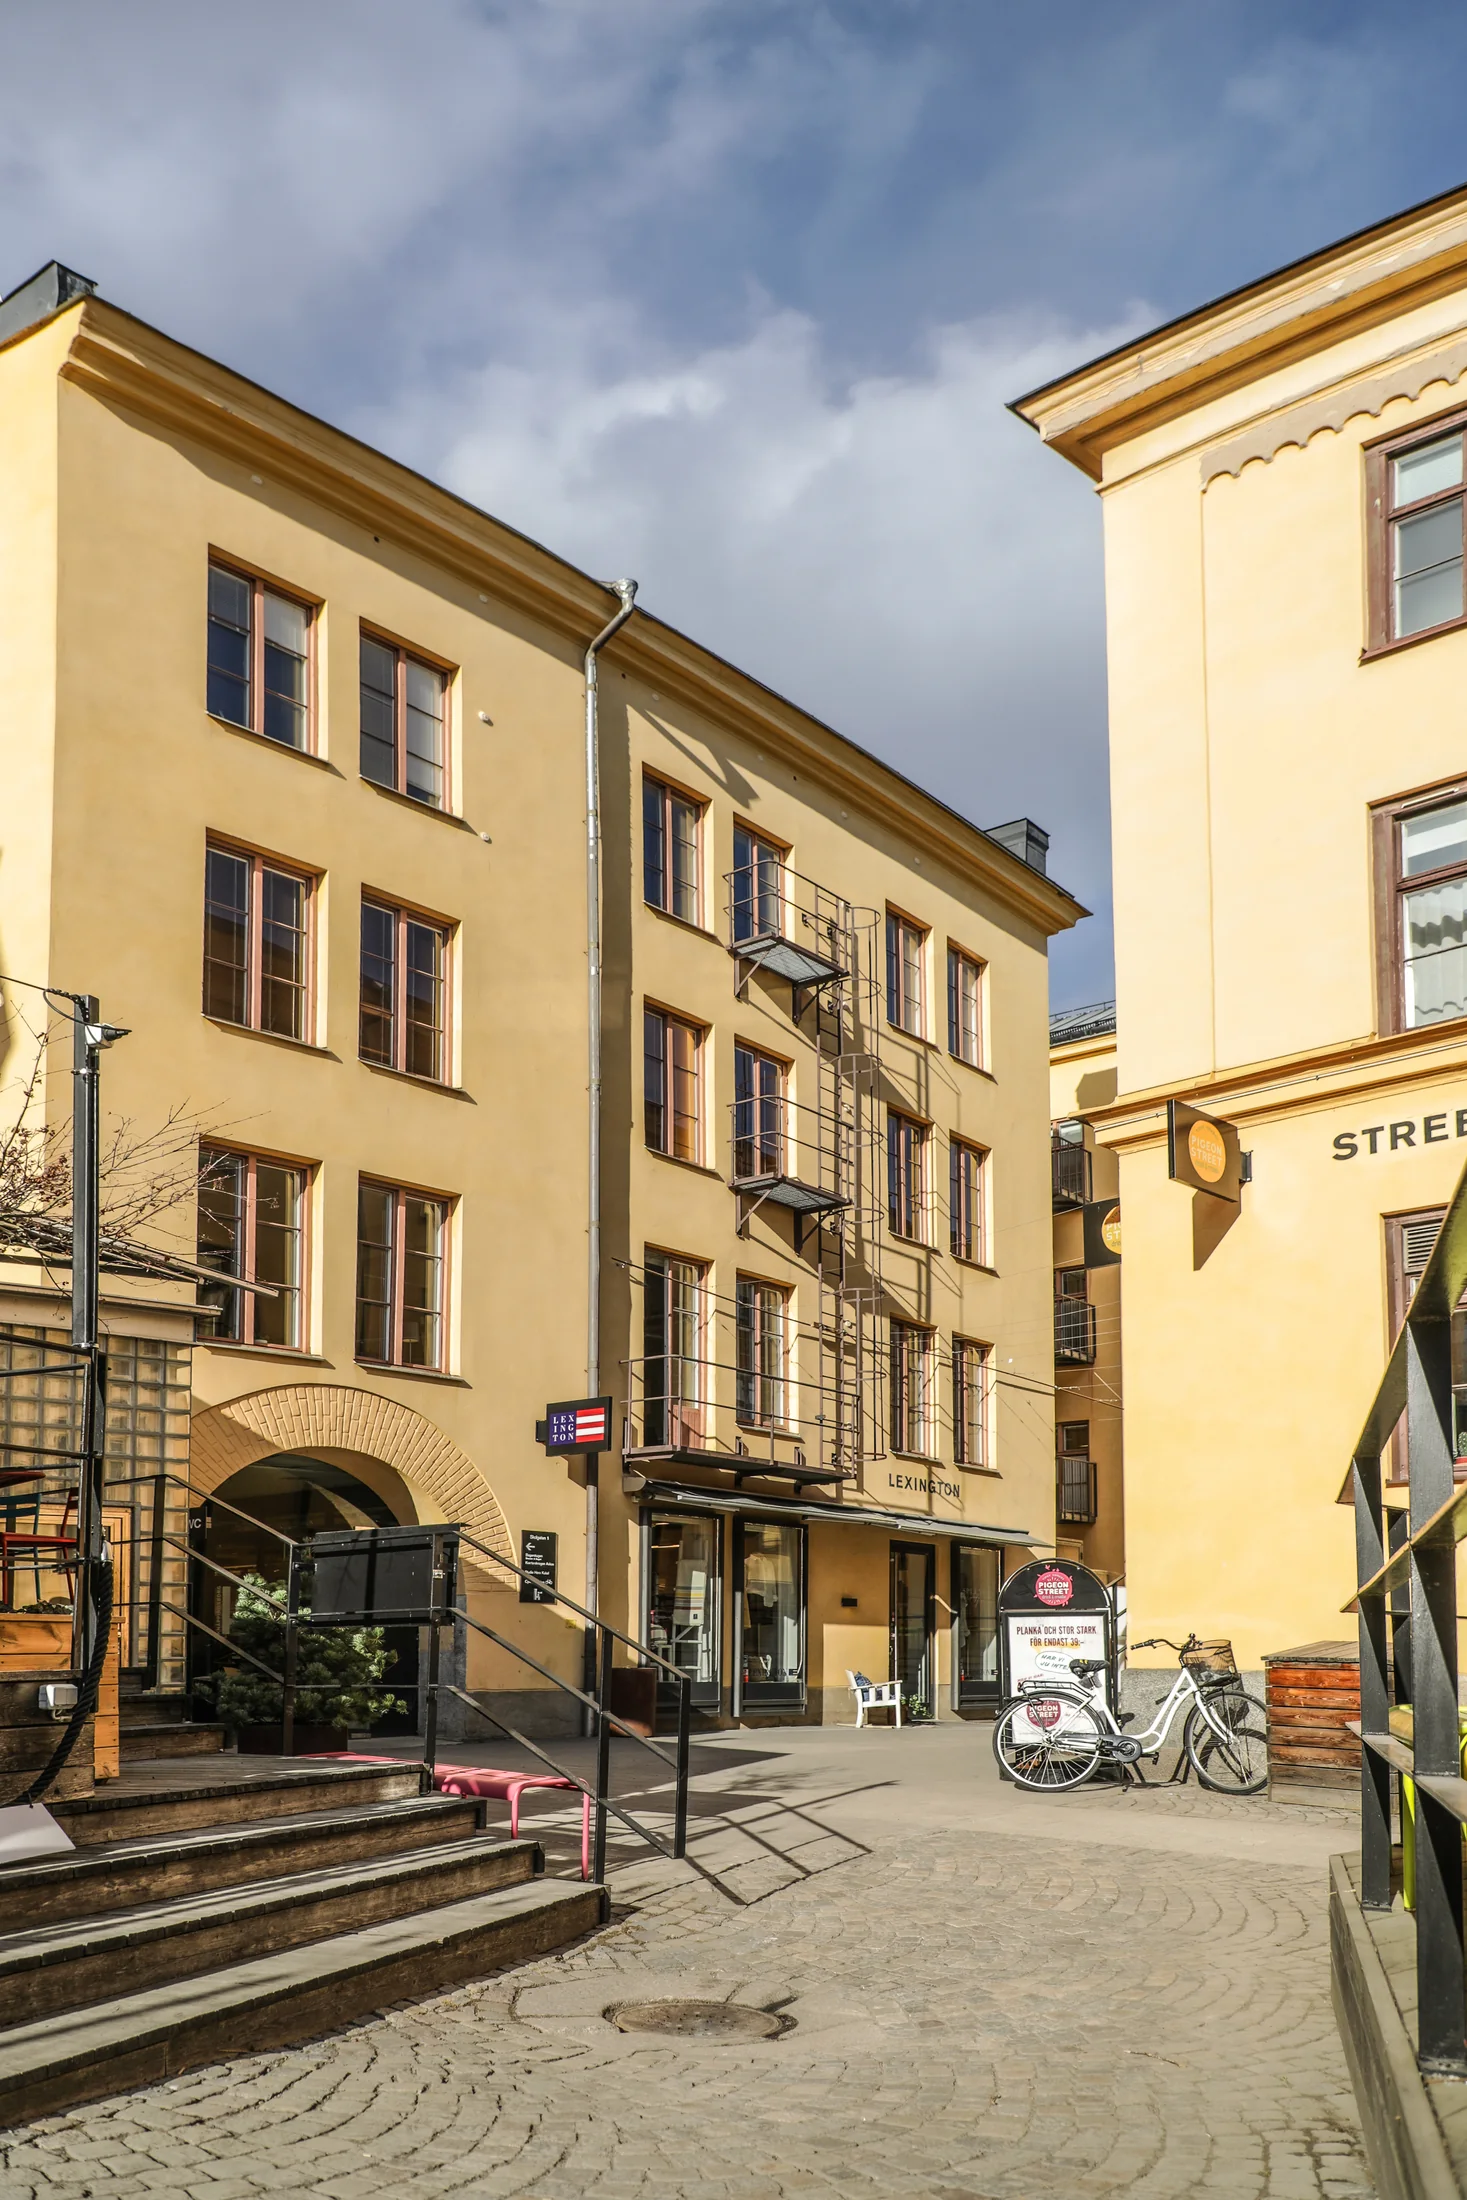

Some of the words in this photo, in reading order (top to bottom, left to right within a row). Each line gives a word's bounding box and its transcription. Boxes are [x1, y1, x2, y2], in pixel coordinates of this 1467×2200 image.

[1191, 1135, 1222, 1156] PIGEON
[1191, 1147, 1222, 1167] STREET
[553, 1414, 574, 1424] LEX
[553, 1424, 574, 1433] ING
[552, 1433, 574, 1442] TON
[888, 1472, 961, 1498] LEXINGTON
[1017, 1627, 1042, 1635] PLANKA
[1044, 1626, 1056, 1635] OCH
[1059, 1626, 1074, 1635] STOR
[1077, 1626, 1096, 1634] STARK
[1030, 1637, 1042, 1646] FÖR
[1044, 1638, 1068, 1646] ENDAST
